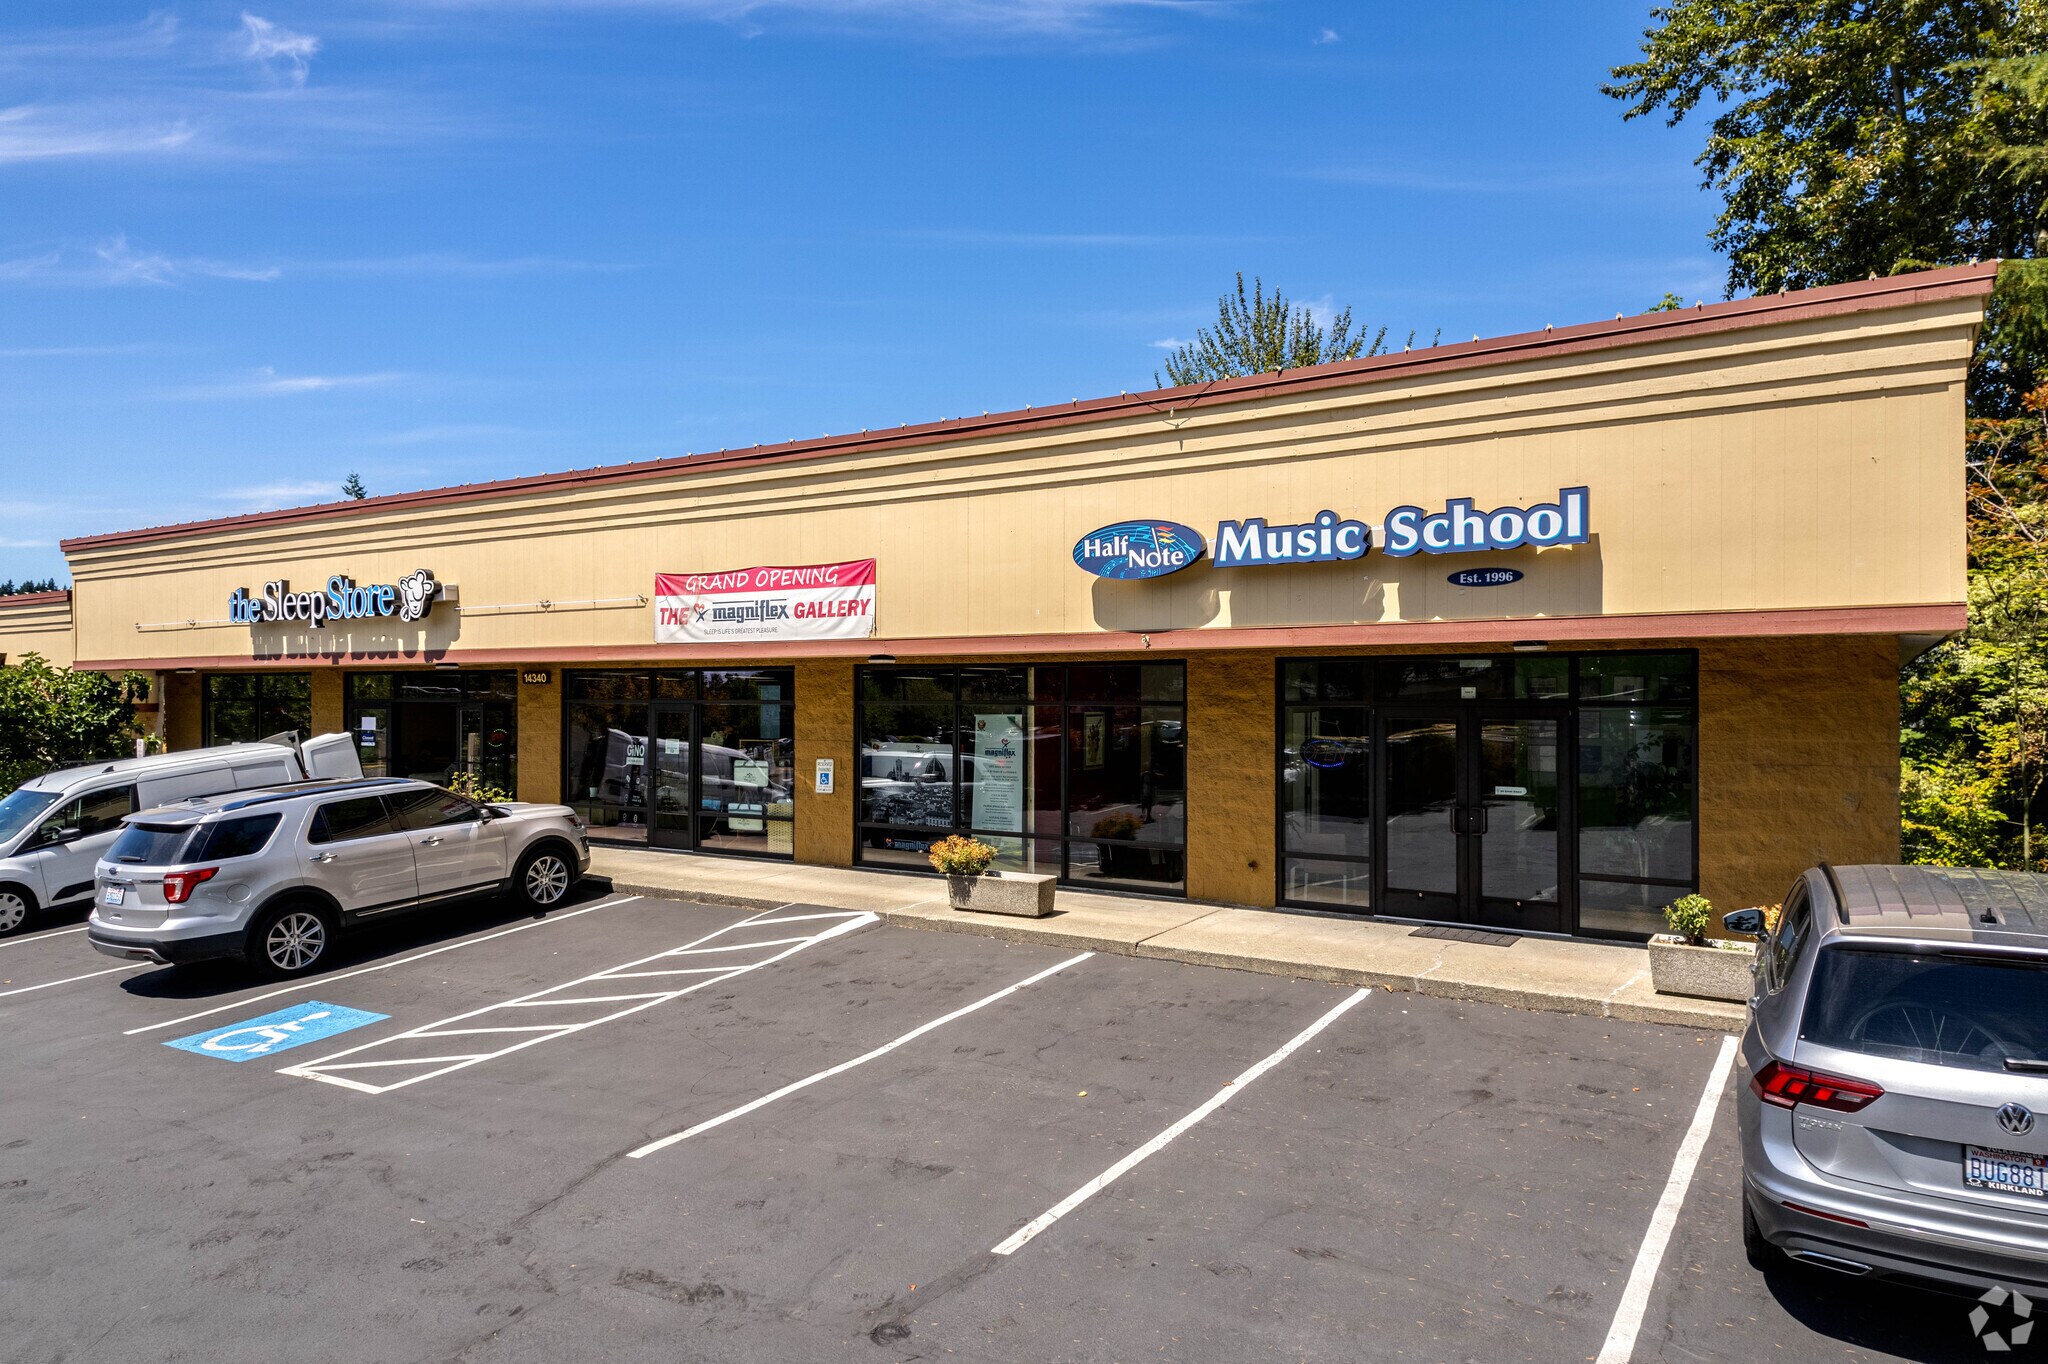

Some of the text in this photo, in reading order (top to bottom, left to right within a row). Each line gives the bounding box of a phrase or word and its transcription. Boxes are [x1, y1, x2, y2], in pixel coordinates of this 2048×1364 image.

[1218, 493, 1584, 562] Music School
[1083, 533, 1129, 559] Half
[1128, 546, 1184, 569] Note
[685, 565, 839, 591] GRAND OPENING
[1459, 571, 1514, 585] Est. 1996
[659, 598, 872, 625] THE magniflex GALLERY
[523, 673, 547, 683] 14340
[893, 838, 930, 851] magniflex
[1971, 1149, 2027, 1163] WASHINGTON
[1987, 1181, 2045, 1197] KIRKLAND
